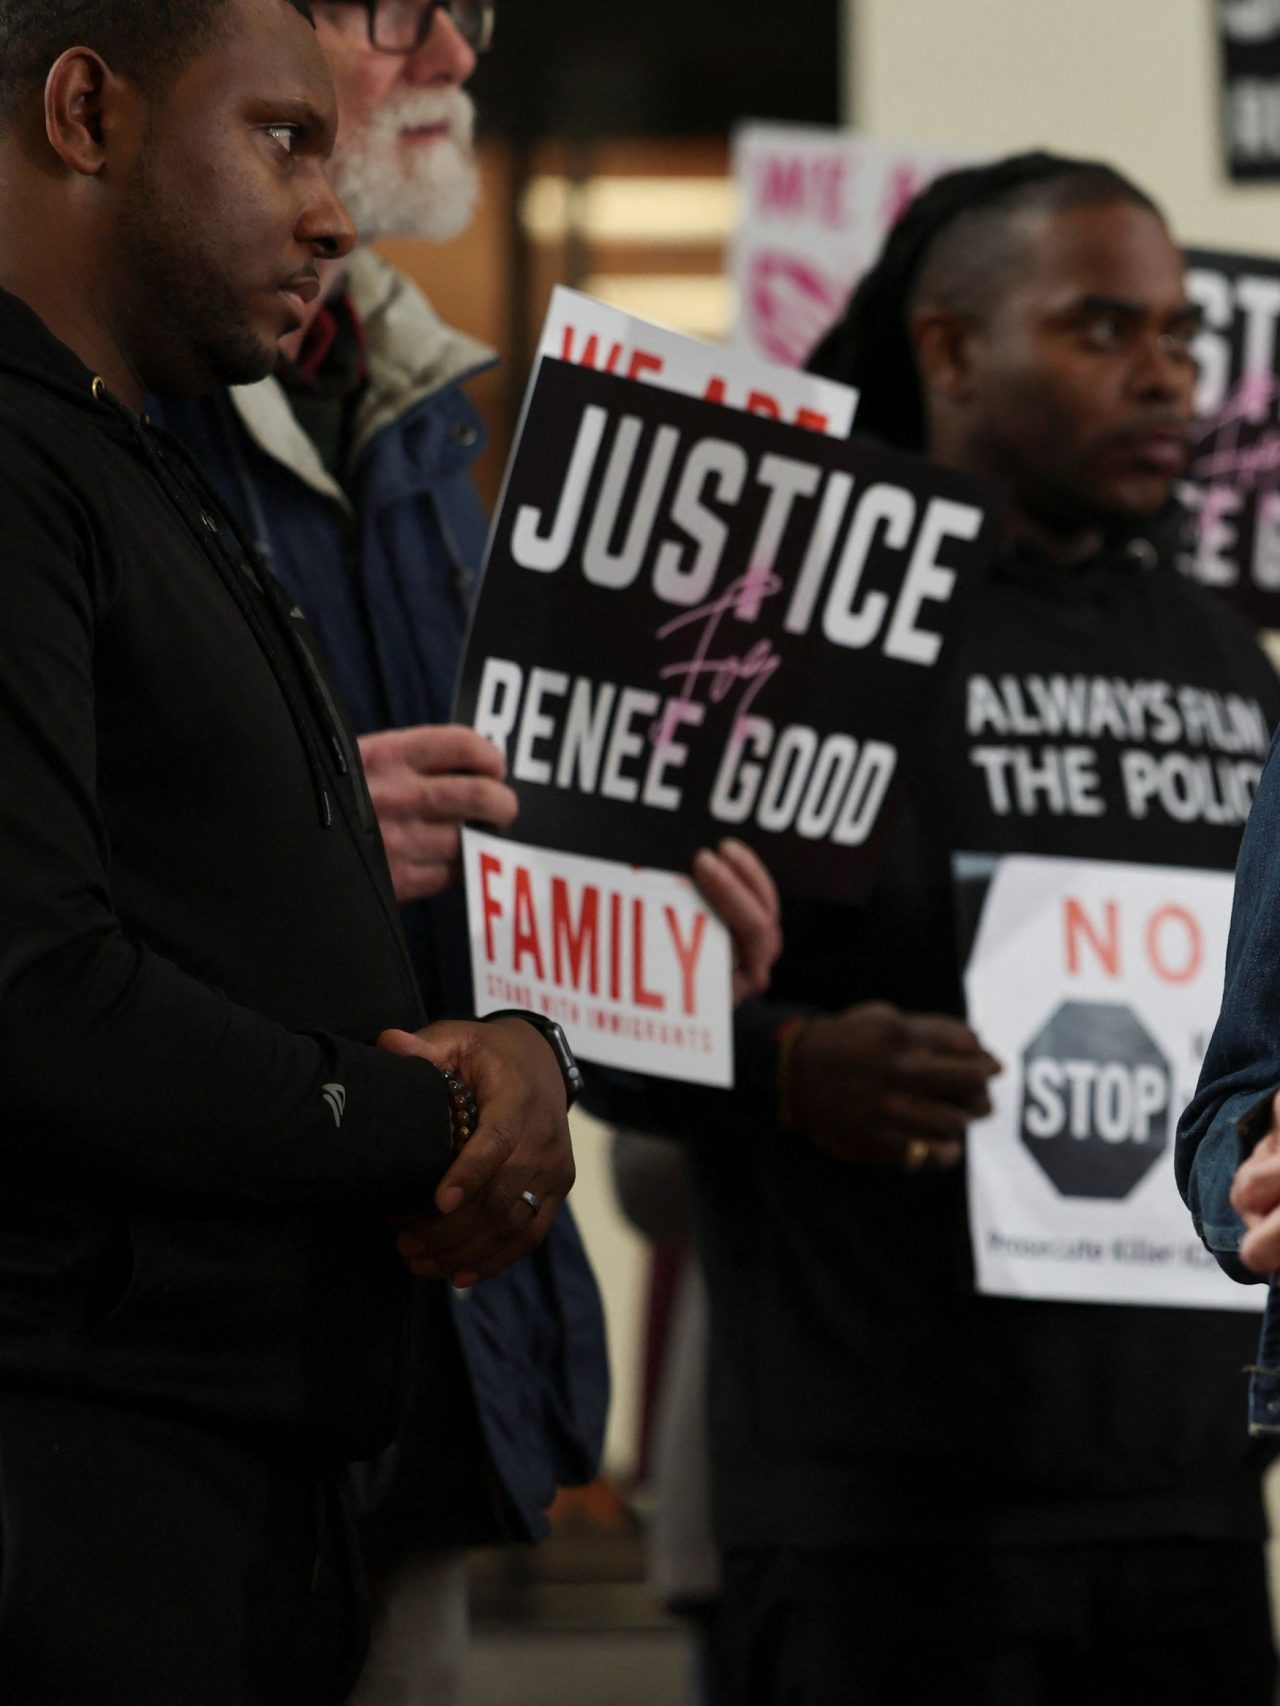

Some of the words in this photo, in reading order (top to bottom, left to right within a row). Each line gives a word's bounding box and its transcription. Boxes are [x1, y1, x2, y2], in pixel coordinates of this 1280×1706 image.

[510, 403, 984, 667] JUSTICE
[472, 655, 704, 812] RENEE
[709, 713, 898, 846] GOOD
[966, 673, 1182, 744] ALWAYS
[969, 744, 1106, 818] THE
[1118, 750, 1262, 826] POLIC
[479, 851, 708, 1016] FAMILY
[1024, 1056, 1168, 1143] STOP
